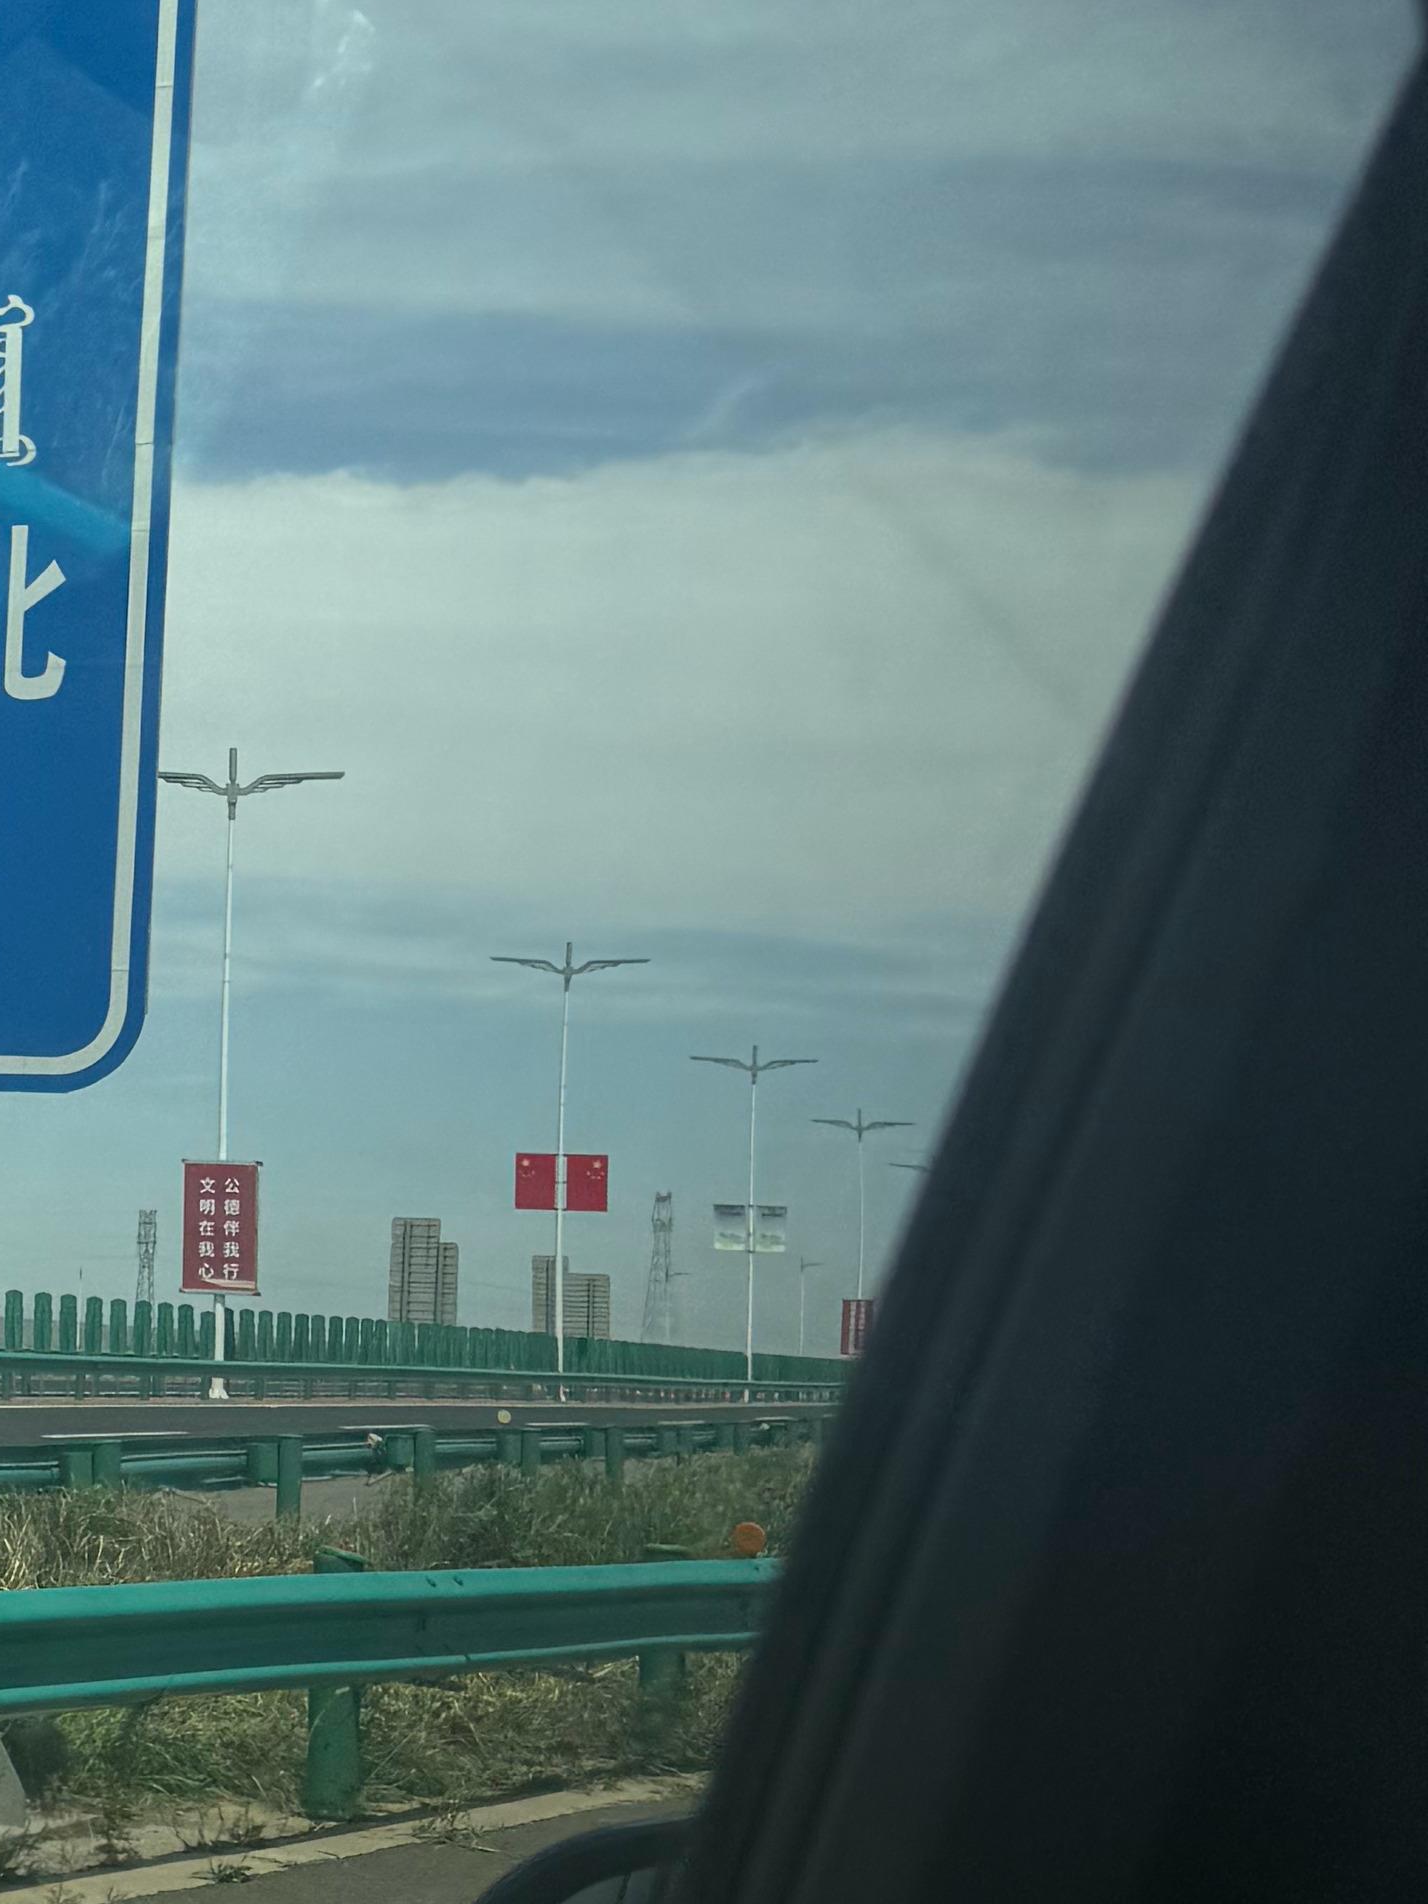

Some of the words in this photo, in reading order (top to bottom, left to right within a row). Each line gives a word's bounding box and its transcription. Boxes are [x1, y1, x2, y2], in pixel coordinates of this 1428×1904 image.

[198, 1177, 216, 1279] 文明在我心
[223, 1178, 240, 1280] 公德伴我行
